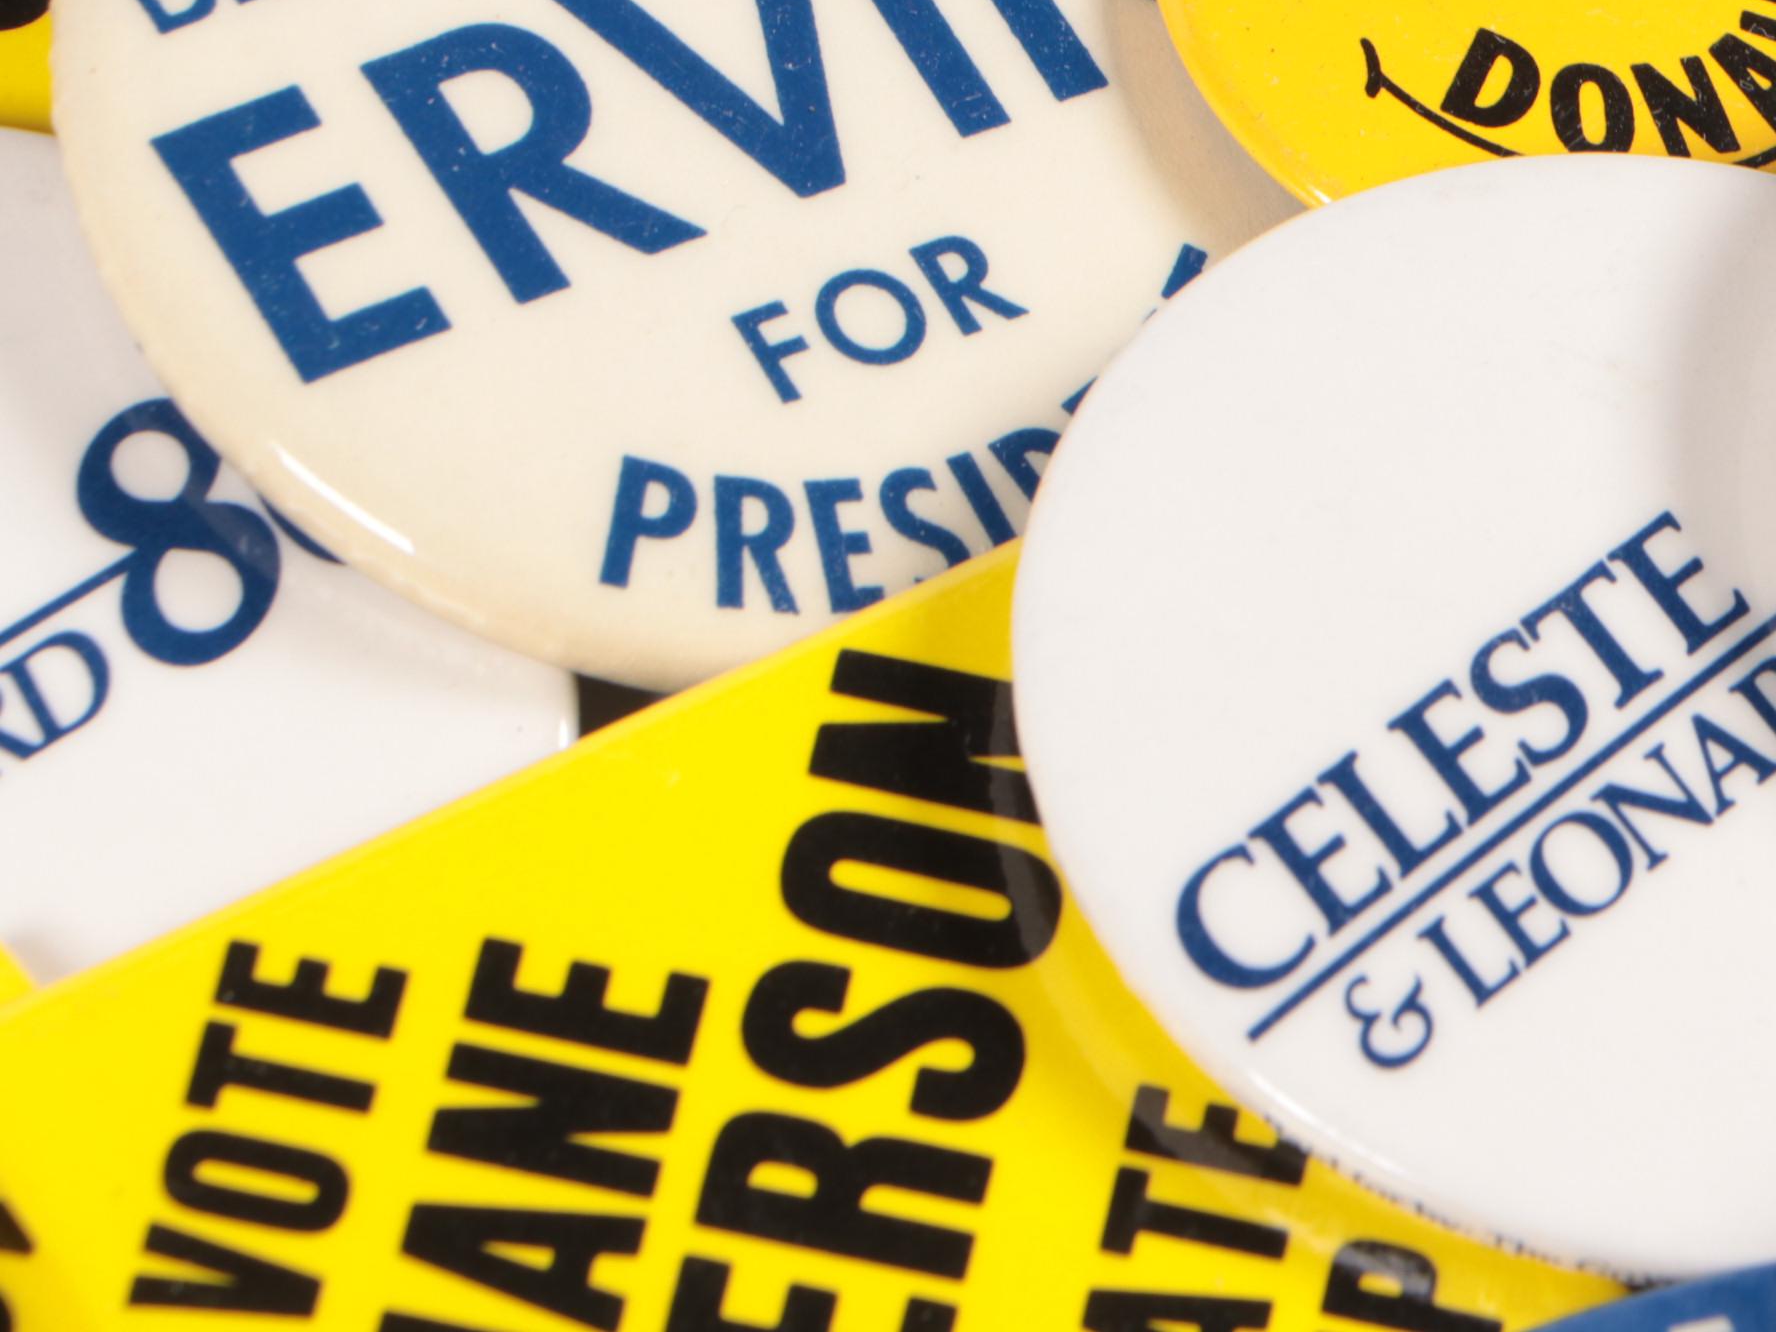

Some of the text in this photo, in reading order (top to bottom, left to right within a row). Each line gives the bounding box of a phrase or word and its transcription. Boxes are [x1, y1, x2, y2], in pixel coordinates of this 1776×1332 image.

[731, 235, 1031, 405] FOR
[1174, 509, 1751, 991] CELESTE
[127, 937, 410, 1318] VOTE
[378, 935, 711, 1332] ANE
[1344, 972, 1434, 1071] &
